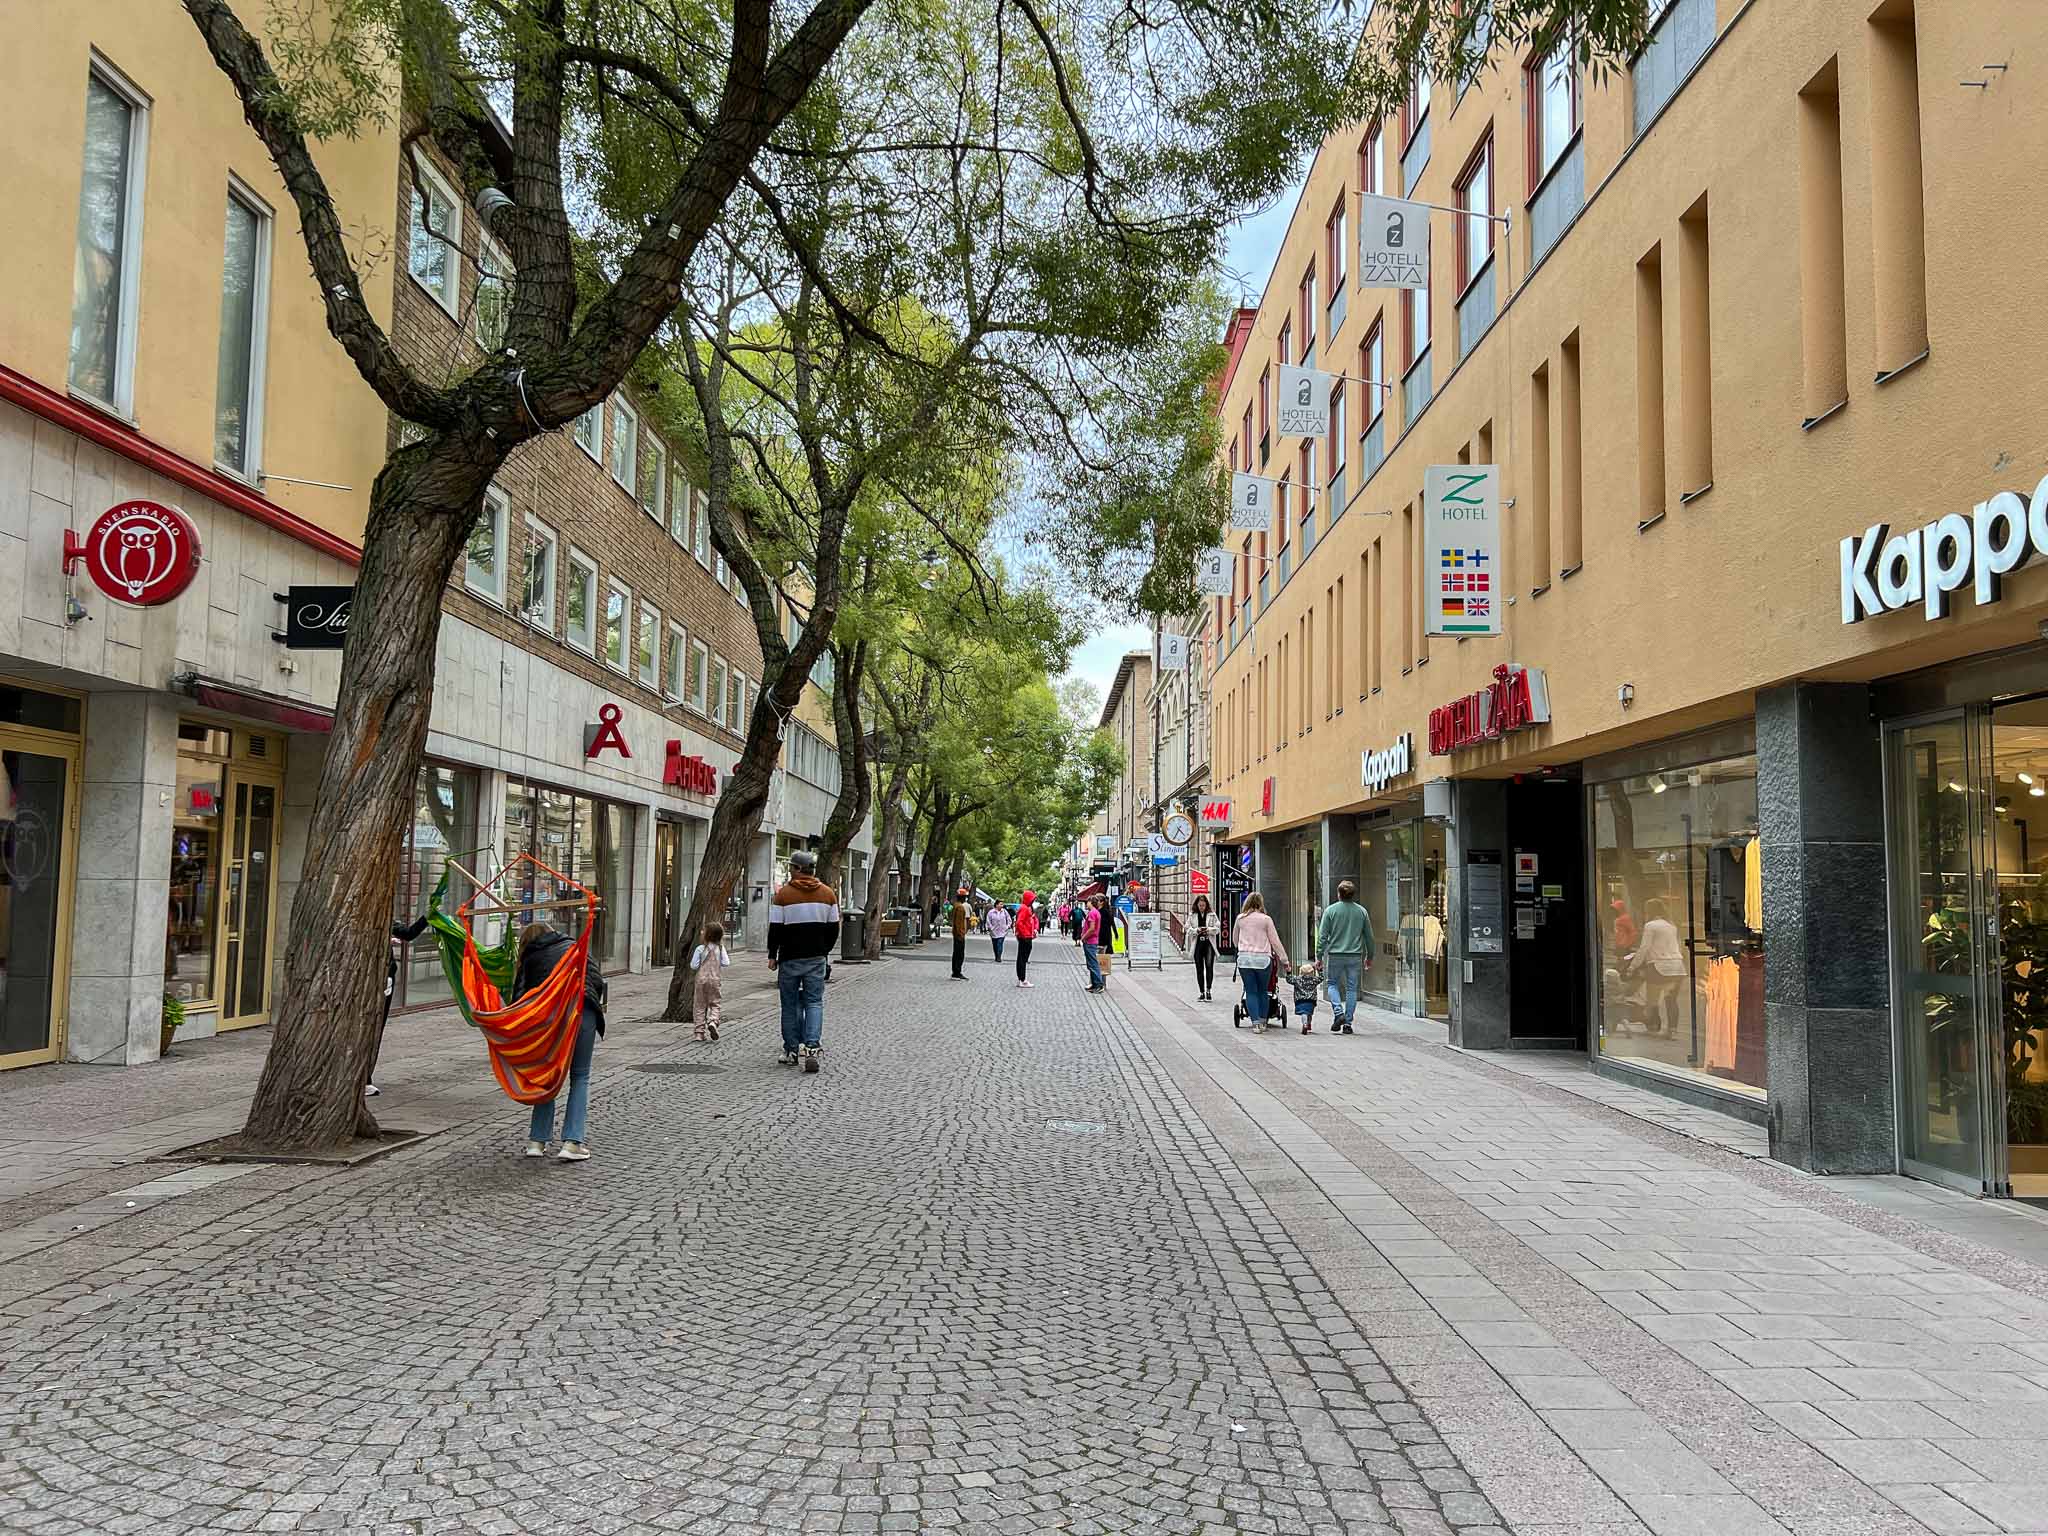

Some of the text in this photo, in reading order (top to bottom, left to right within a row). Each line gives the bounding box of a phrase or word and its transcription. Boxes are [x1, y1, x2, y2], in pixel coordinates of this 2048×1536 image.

[1390, 230, 1401, 243] Z
[1366, 251, 1424, 266] HOTELL
[1282, 408, 1325, 420] HOTELL
[1440, 473, 1489, 505] Z
[98, 506, 181, 537] SVENSKA BIO
[1232, 508, 1269, 518] HOTELL
[1442, 507, 1489, 521] HOTEL
[586, 703, 632, 758] Å
[1428, 689, 1485, 757] HOTELL
[1361, 732, 1411, 791] Kappahl
[1201, 801, 1229, 823] H&M
